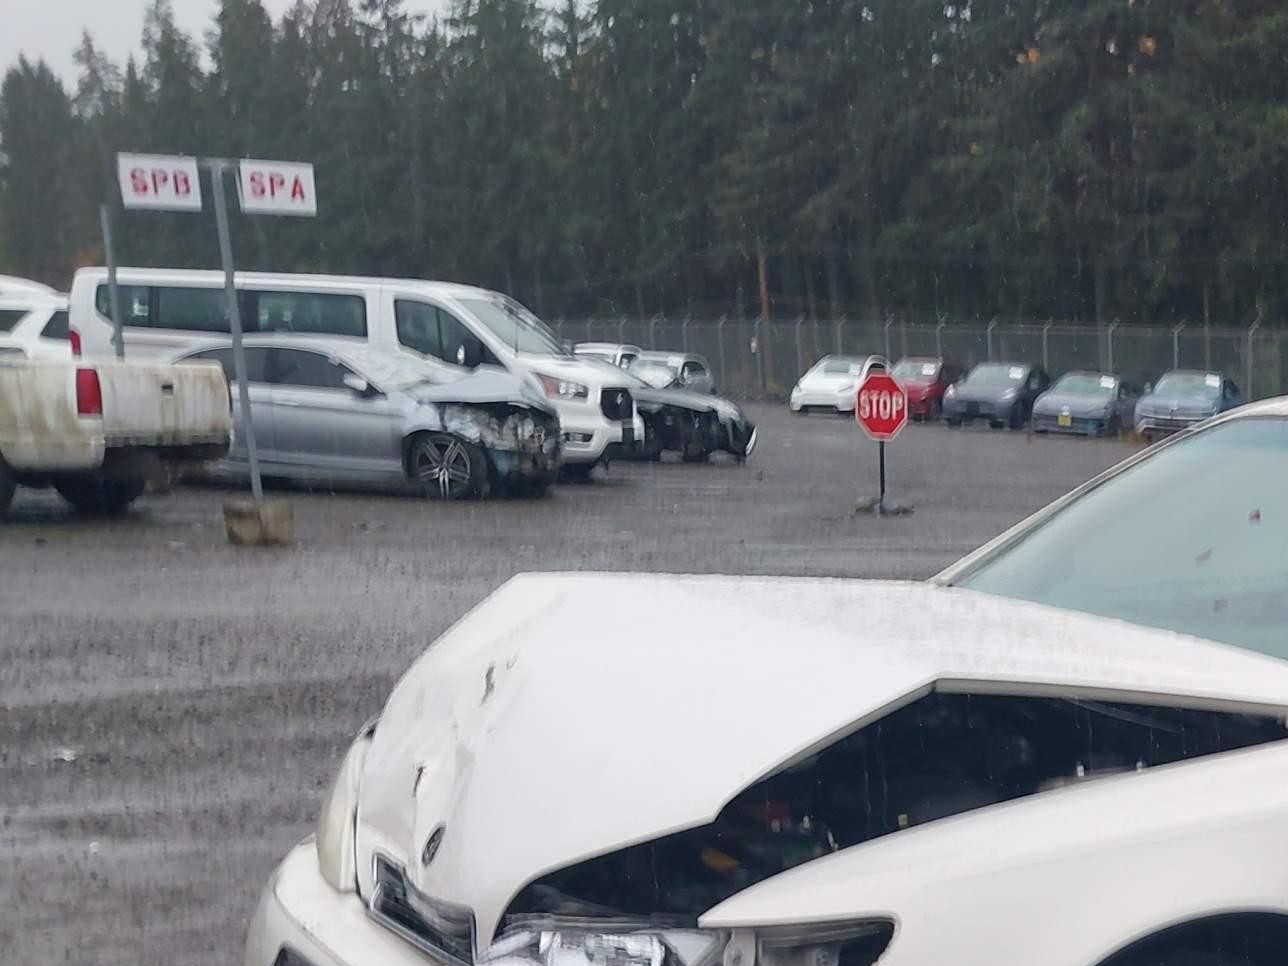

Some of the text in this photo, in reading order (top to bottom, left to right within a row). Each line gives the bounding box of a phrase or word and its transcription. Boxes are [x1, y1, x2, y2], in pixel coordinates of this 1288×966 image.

[130, 168, 191, 196] SPB
[250, 170, 305, 201] SPA
[860, 389, 903, 420] STOP
